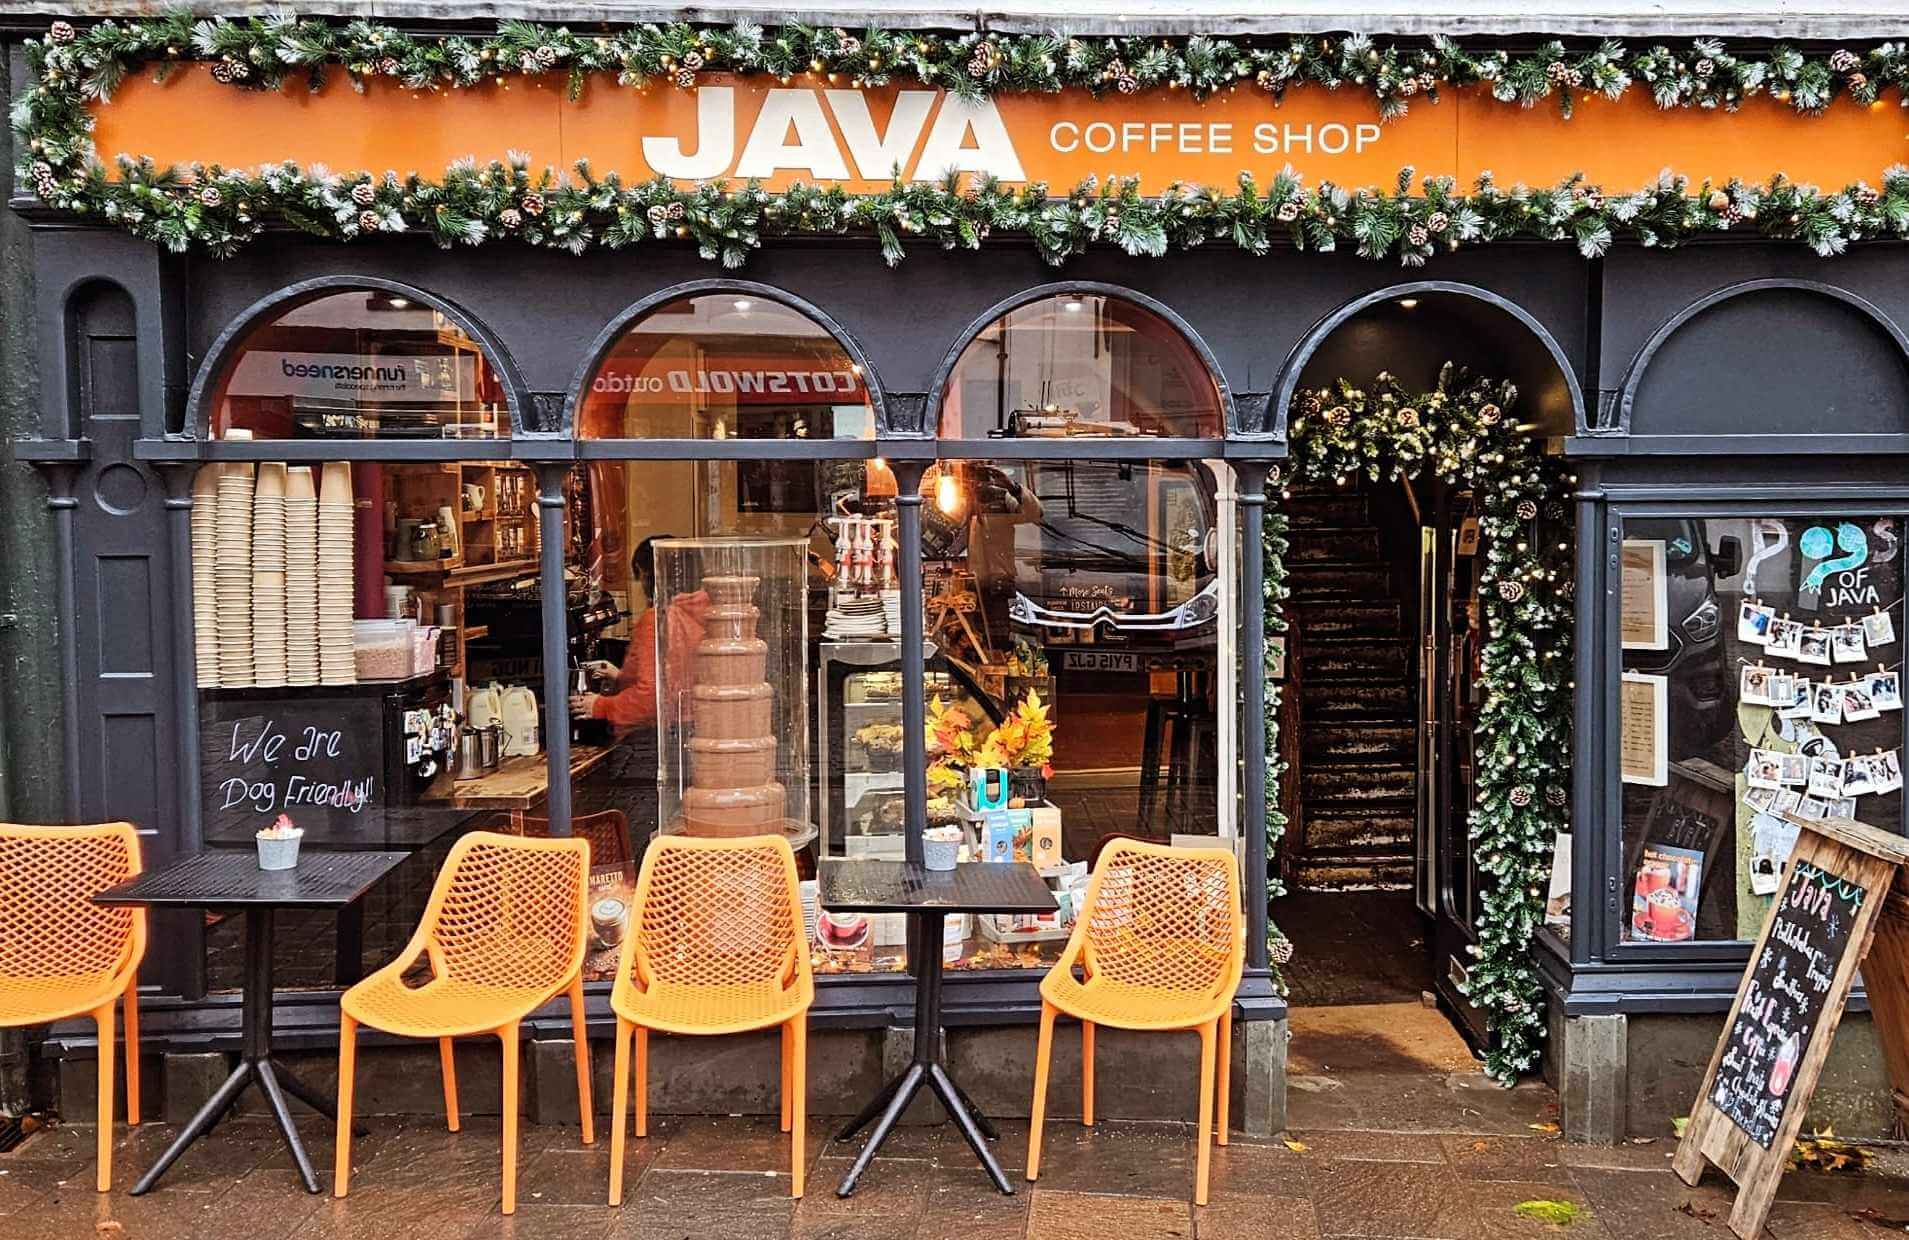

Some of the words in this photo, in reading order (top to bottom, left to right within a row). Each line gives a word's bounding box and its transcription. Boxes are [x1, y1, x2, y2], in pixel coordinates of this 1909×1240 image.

[641, 86, 1028, 182] JAVA
[1049, 121, 1233, 154] COFFEE
[1252, 122, 1382, 155] SHOP
[1838, 567, 1871, 589] OF
[1826, 585, 1880, 607] JAVA
[229, 720, 286, 764] We
[295, 726, 342, 760] are
[219, 777, 275, 813] Dog
